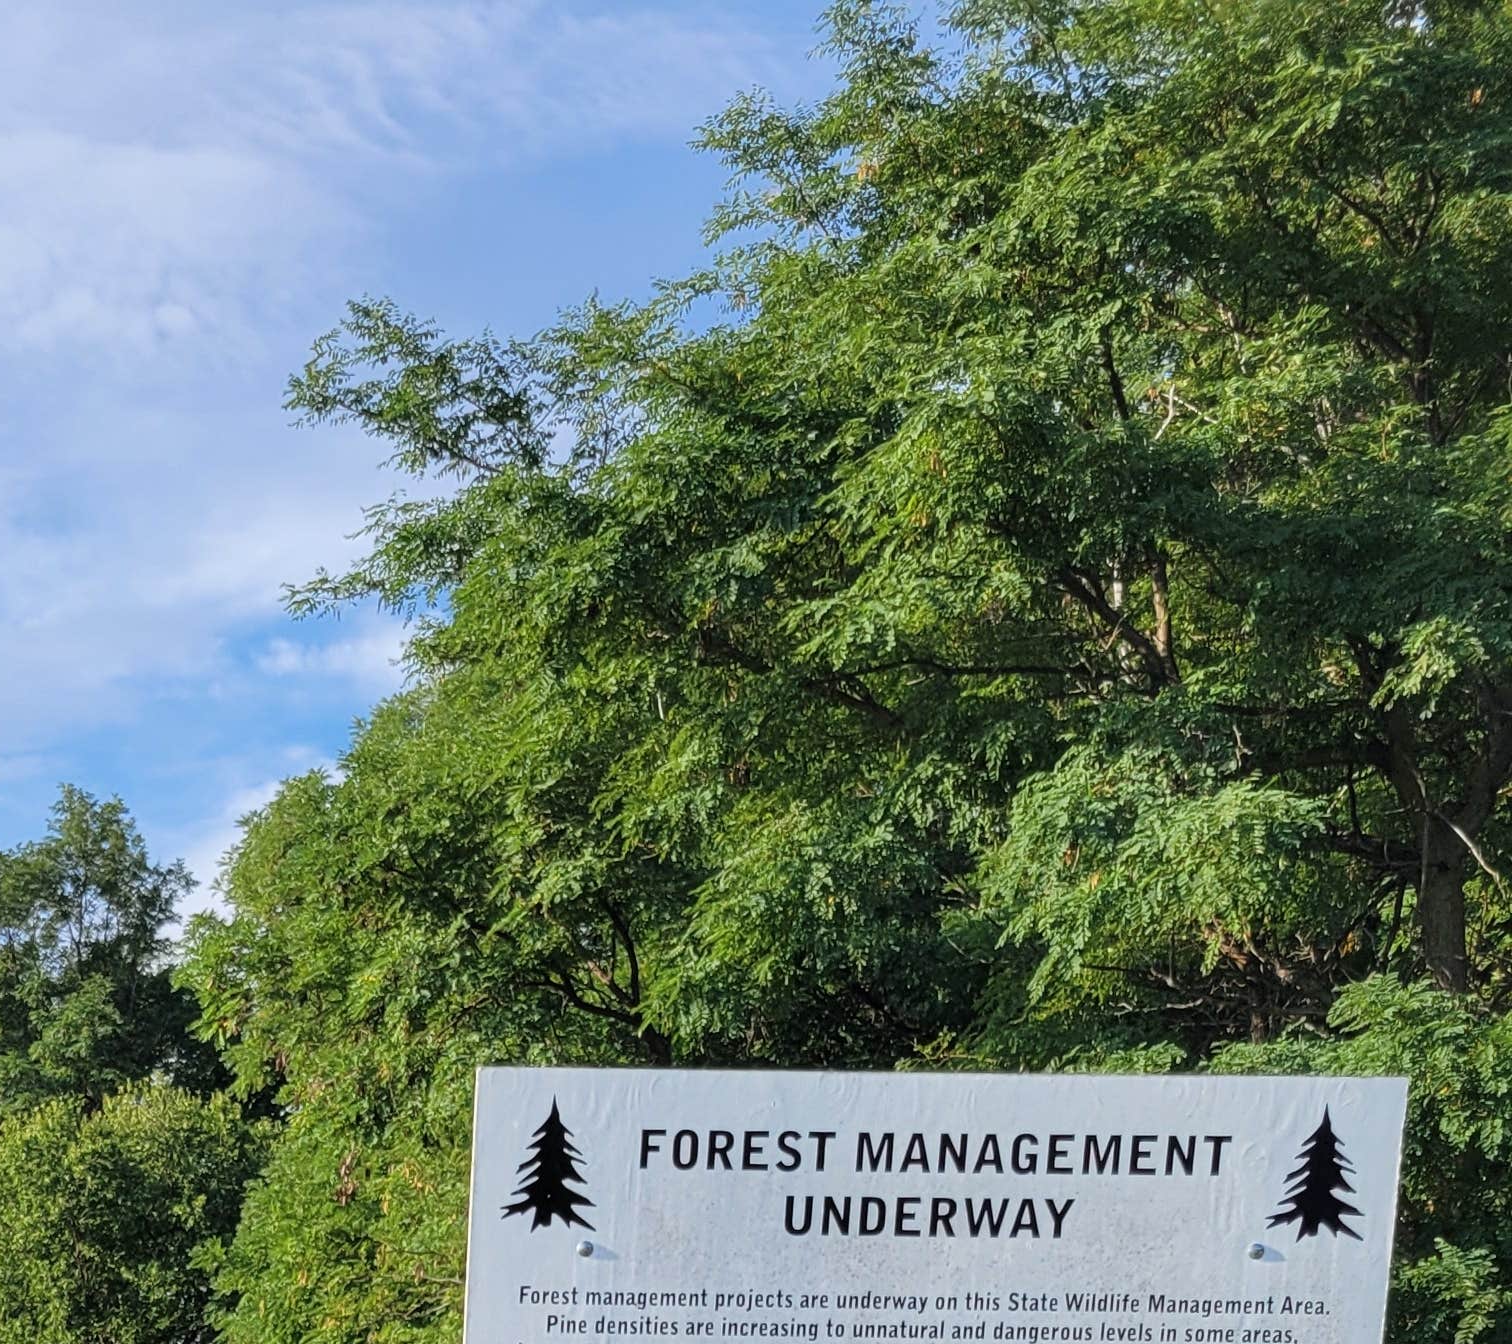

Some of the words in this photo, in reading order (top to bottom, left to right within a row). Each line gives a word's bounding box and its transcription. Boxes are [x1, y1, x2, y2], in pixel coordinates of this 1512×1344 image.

[639, 1129, 837, 1172] FOREST
[855, 1132, 1233, 1176] MANAGEMENT
[784, 1195, 1076, 1239] UNDERWAY
[519, 1285, 579, 1306] Forest
[585, 1288, 708, 1311] management
[714, 1288, 793, 1313] projects
[799, 1294, 829, 1309] are
[836, 1290, 929, 1315] underway
[935, 1296, 958, 1311] on
[965, 1291, 1001, 1311] this
[1007, 1292, 1058, 1312] State
[1065, 1292, 1140, 1313] Wildlife
[1148, 1294, 1274, 1318] Management
[1279, 1295, 1330, 1316] Area.
[546, 1314, 587, 1334] Pine
[595, 1315, 678, 1336] densities
[685, 1321, 714, 1336] are
[722, 1317, 819, 1342] increasing
[826, 1318, 845, 1338] to
[853, 1320, 945, 1339] unnatural
[951, 1320, 986, 1340] and
[993, 1321, 1093, 1344] dangerous
[1100, 1321, 1153, 1342] levels
[1160, 1322, 1177, 1342] in
[1184, 1328, 1235, 1343] some
